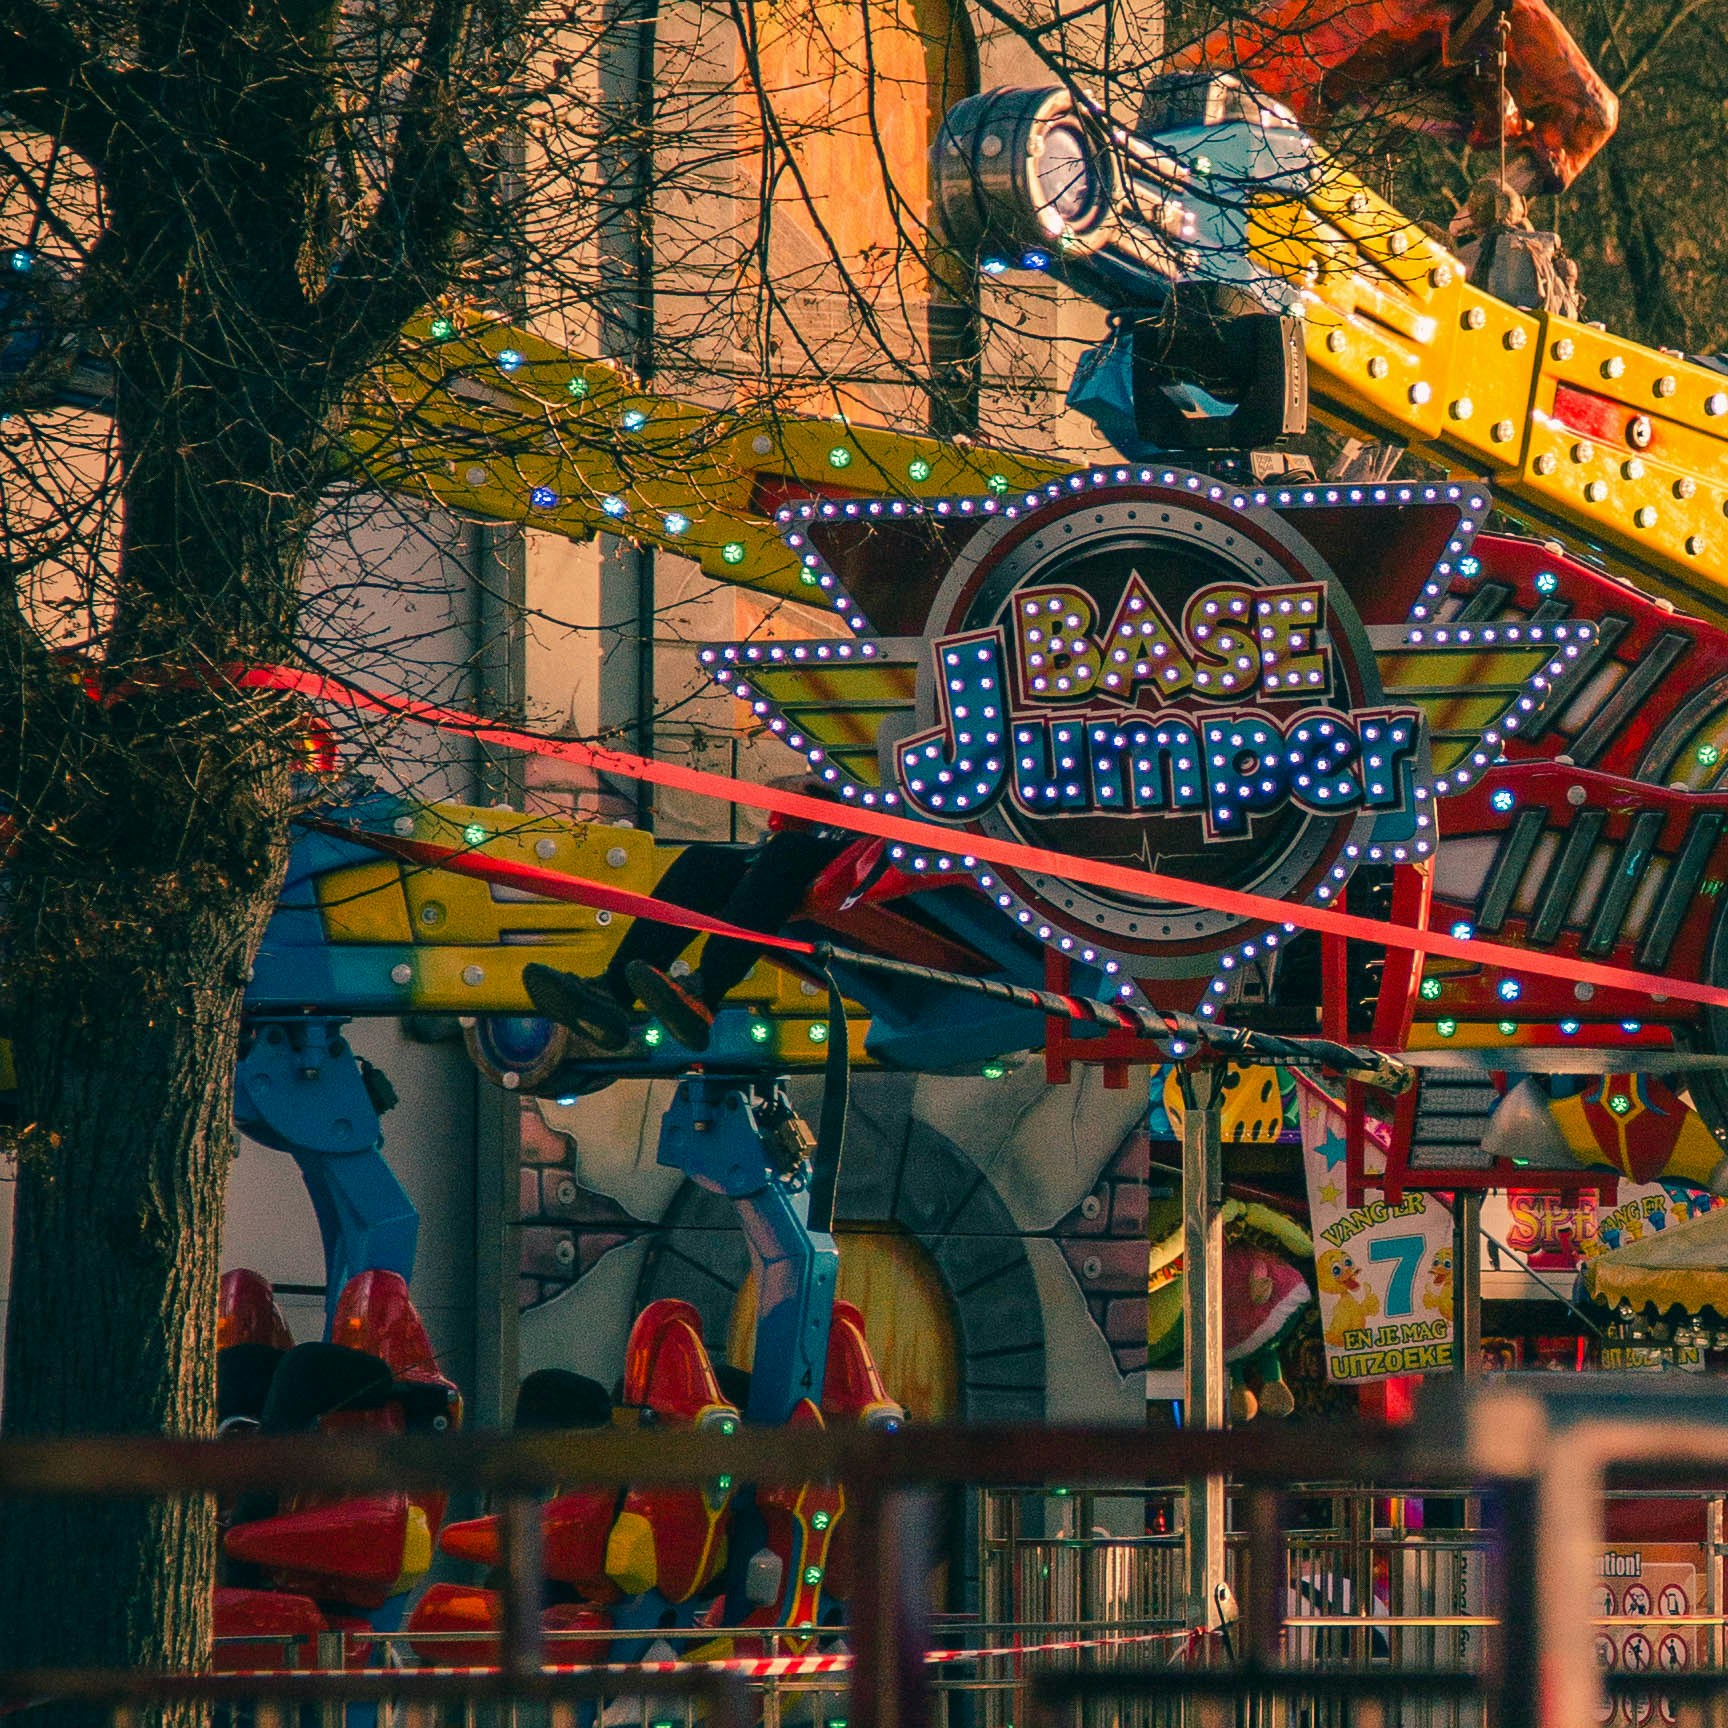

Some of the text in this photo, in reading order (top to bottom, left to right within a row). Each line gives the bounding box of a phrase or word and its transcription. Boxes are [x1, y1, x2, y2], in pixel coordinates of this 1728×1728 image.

[1011, 568, 1334, 708] BASE
[894, 625, 1425, 843] Jumper
[1320, 1200, 1390, 1248] VANG
[1366, 1232, 1427, 1319] 7
[1342, 1319, 1448, 1351] EN JE MAG
[800, 1367, 813, 1392] 4
[1330, 1343, 1454, 1379] UITZOEKE
